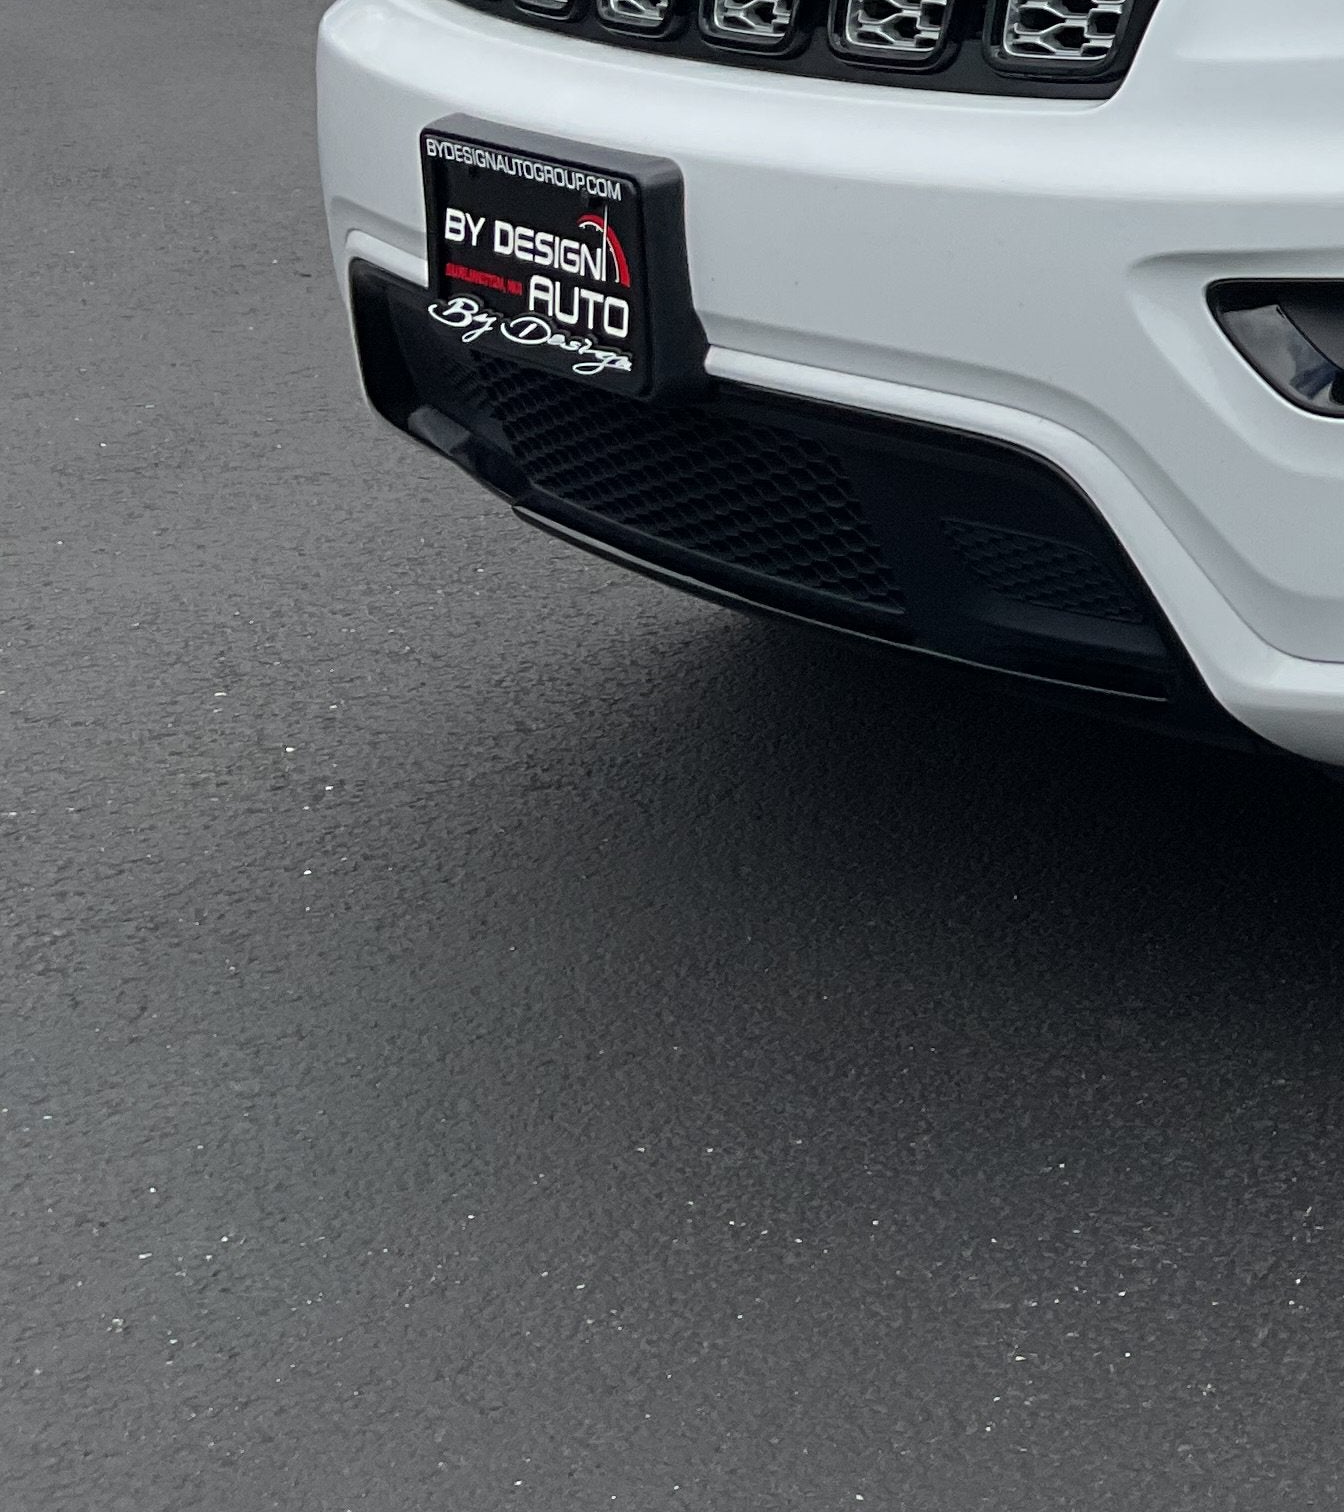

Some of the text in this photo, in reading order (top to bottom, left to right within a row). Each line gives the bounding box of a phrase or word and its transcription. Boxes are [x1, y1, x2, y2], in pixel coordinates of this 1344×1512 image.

[426, 138, 622, 202] BYDESIGNAUTOGROUP.COM
[445, 207, 603, 281] BY DESIGN
[428, 297, 497, 343] By
[529, 274, 630, 339] AUTO
